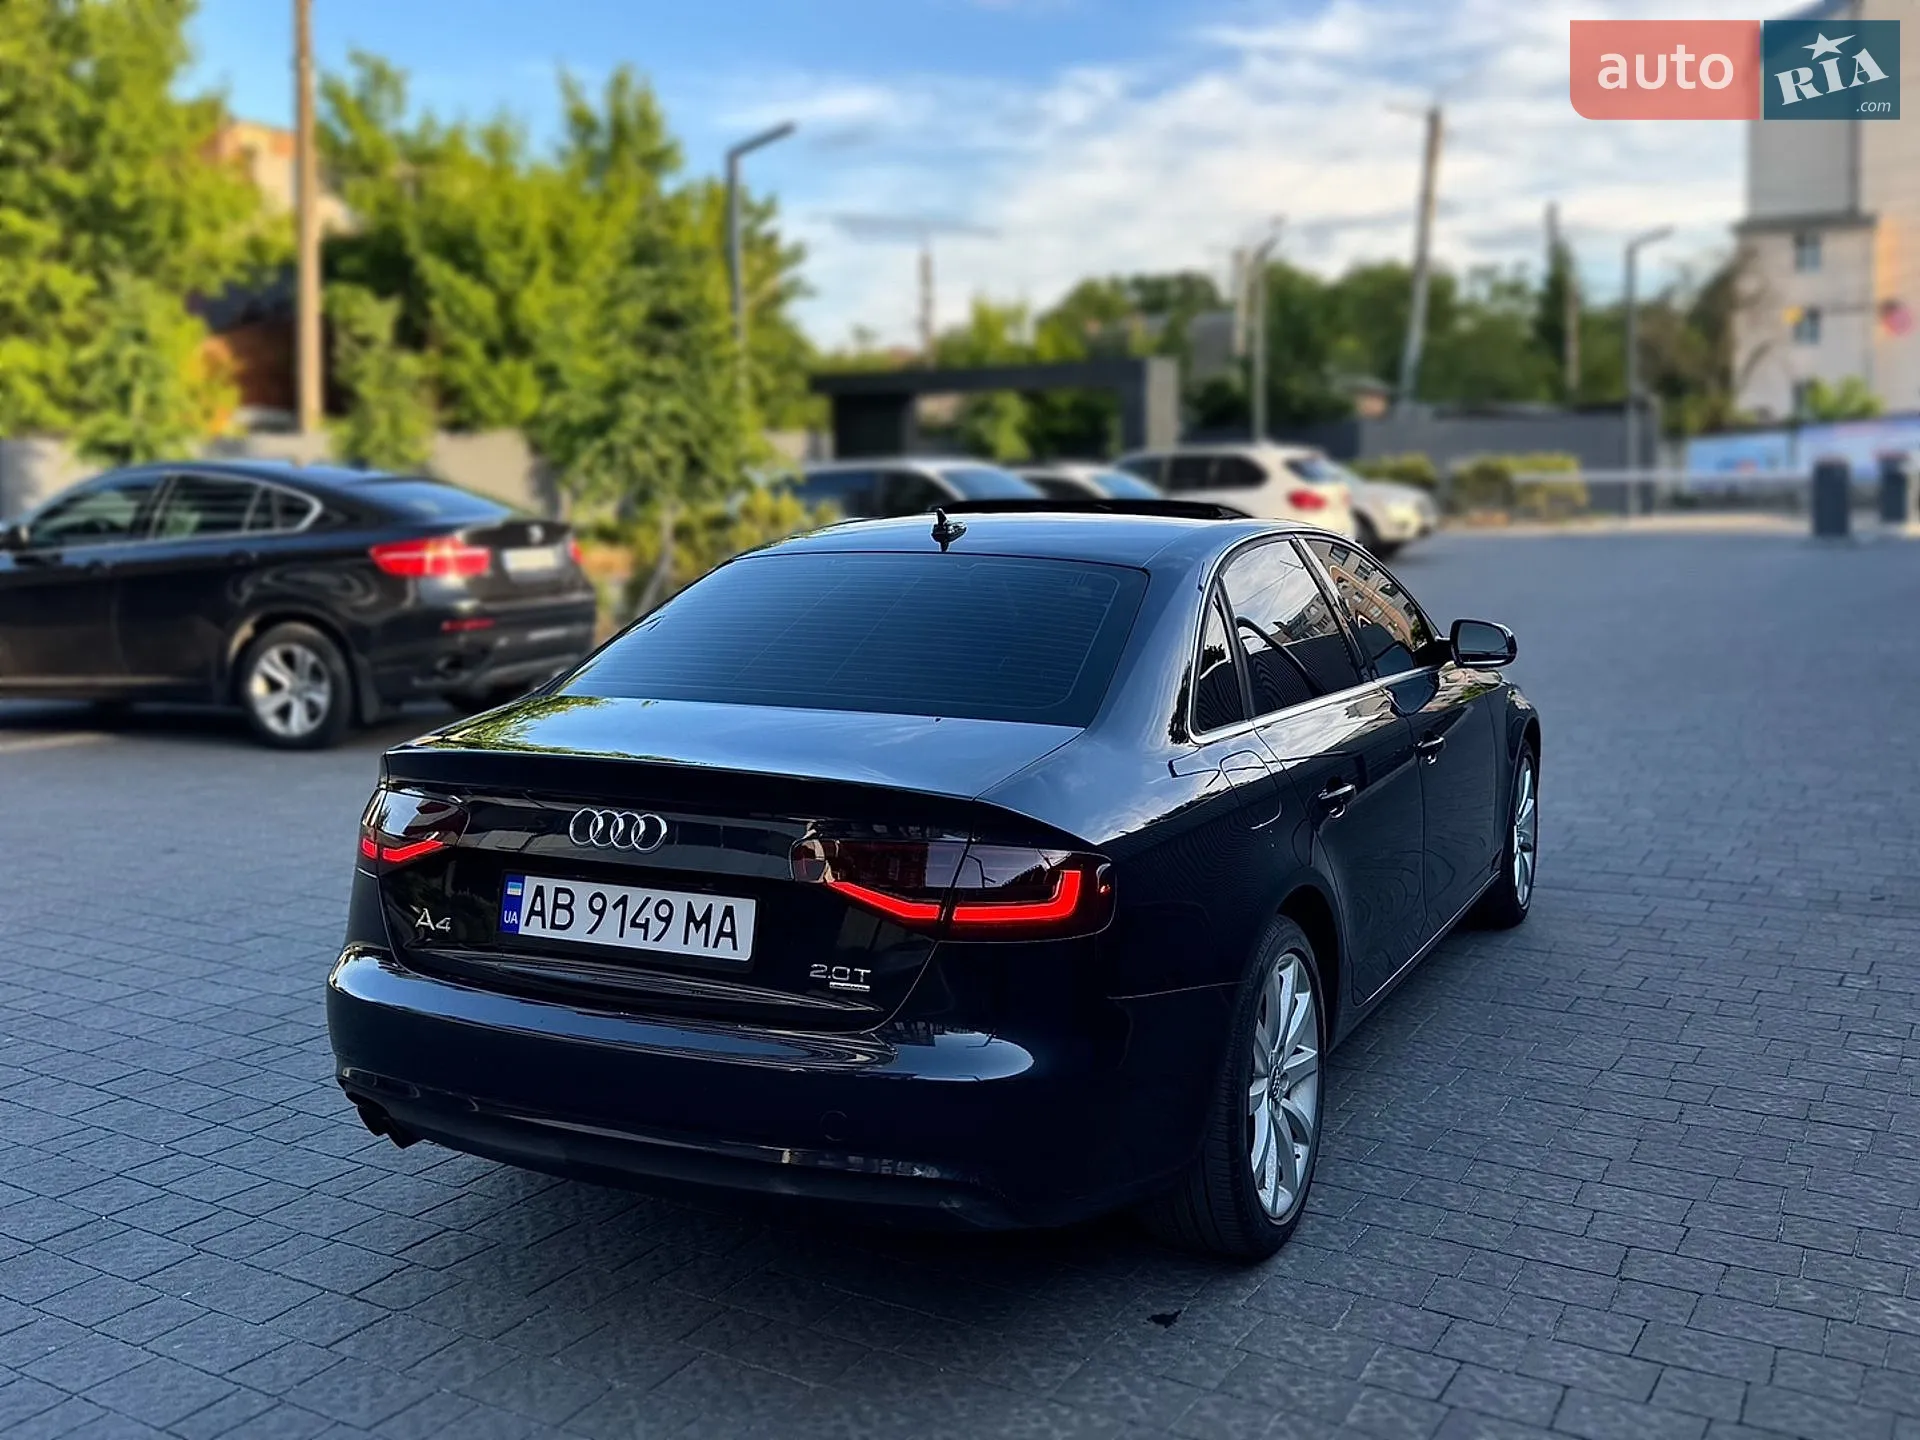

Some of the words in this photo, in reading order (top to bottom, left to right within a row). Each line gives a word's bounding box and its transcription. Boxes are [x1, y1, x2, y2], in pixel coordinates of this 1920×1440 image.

[414, 907, 452, 933] A4
[503, 910, 519, 925] UA
[524, 884, 576, 931] AB
[586, 891, 675, 943] 9149
[682, 900, 739, 951] MA
[809, 963, 872, 983] 2.0T
